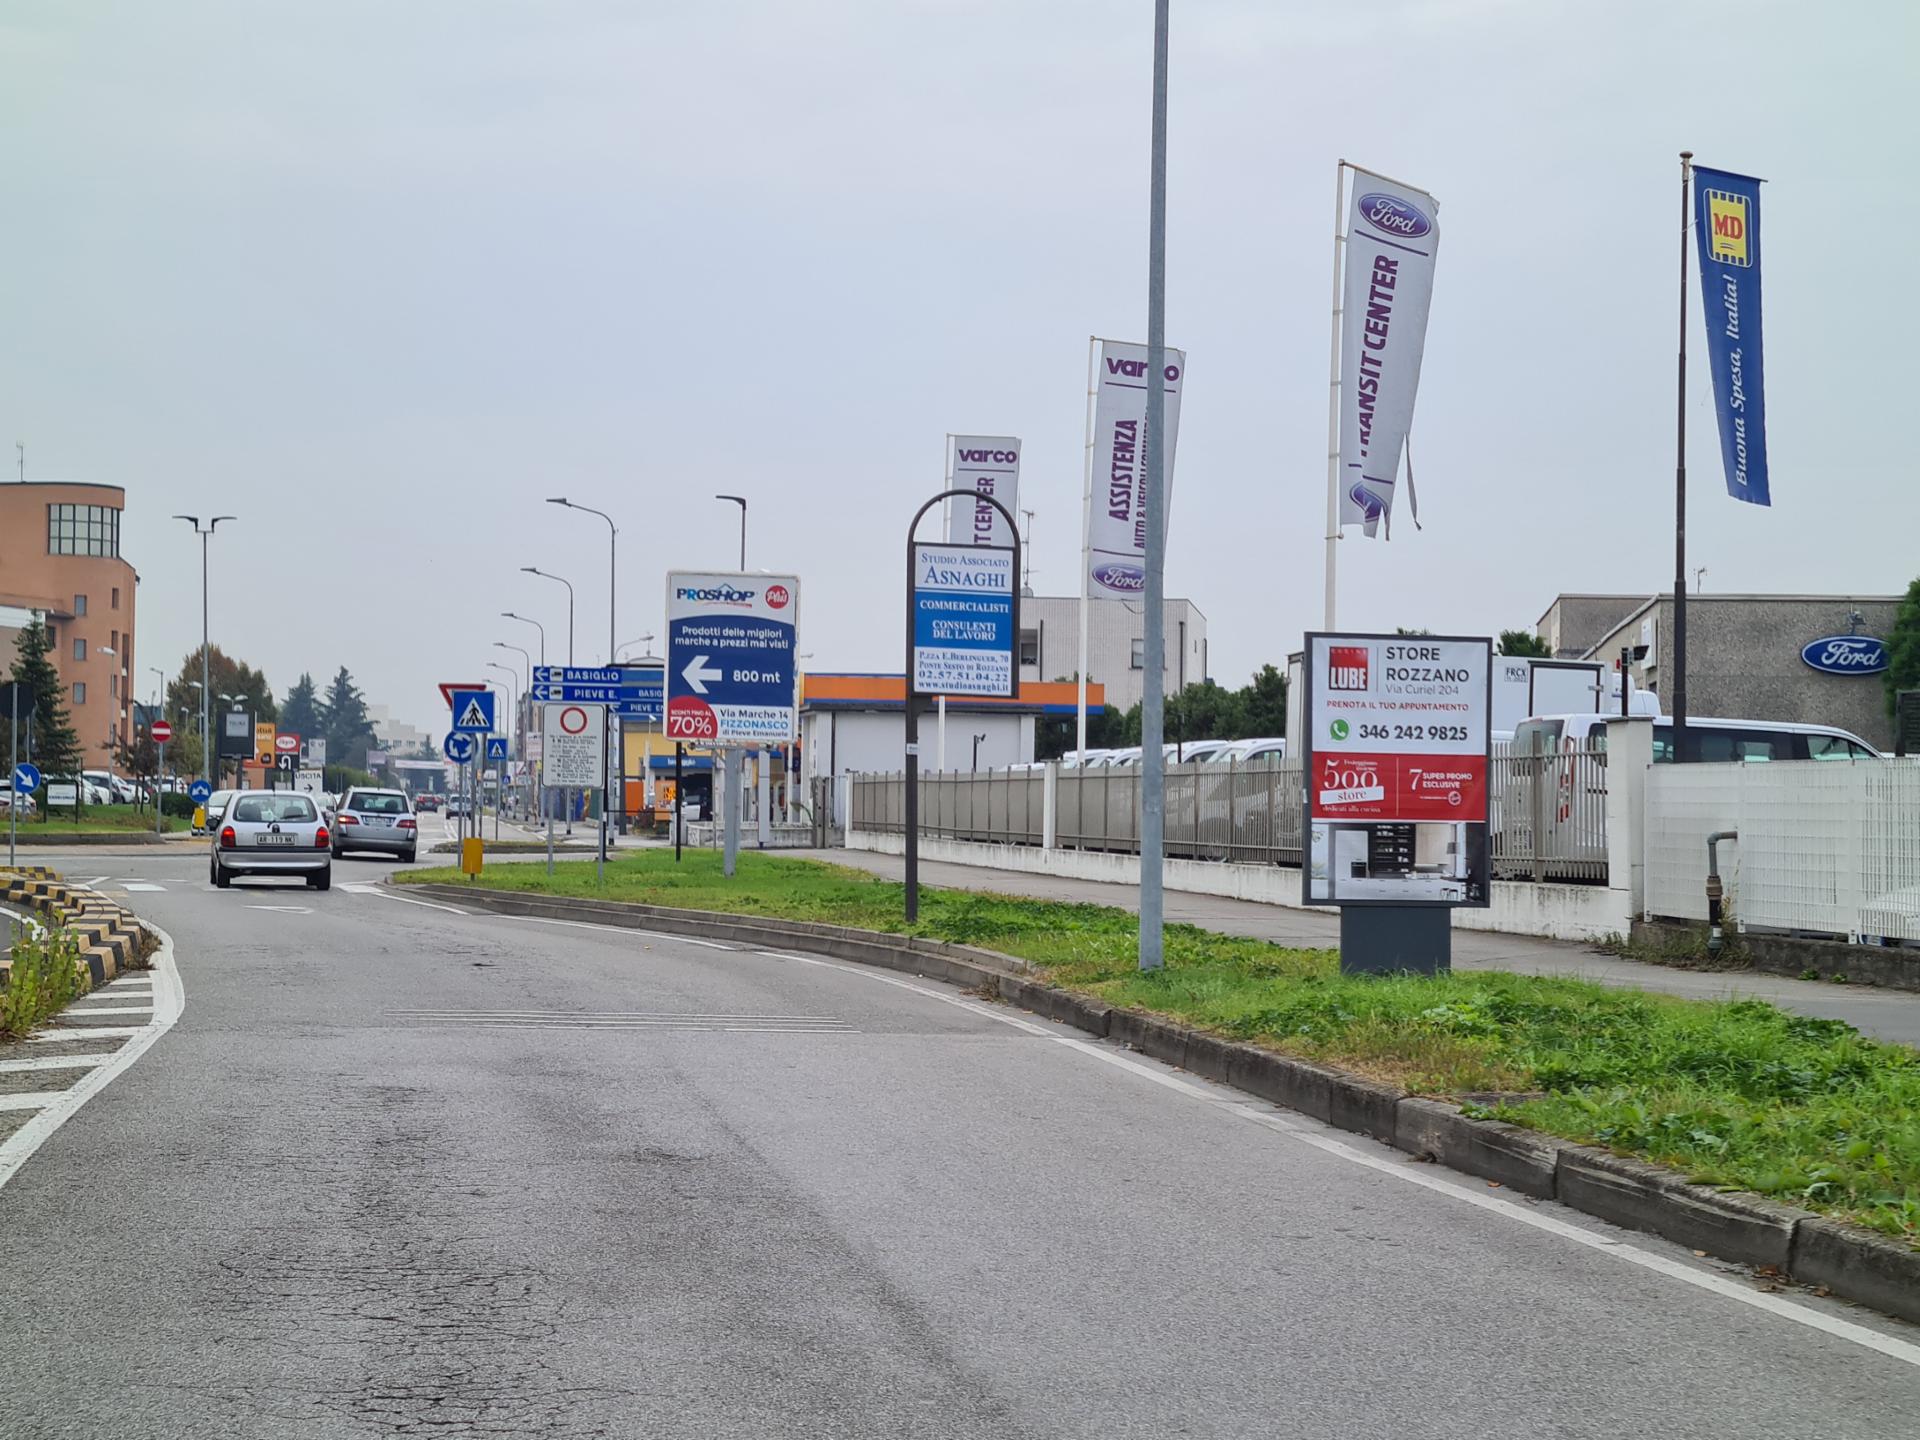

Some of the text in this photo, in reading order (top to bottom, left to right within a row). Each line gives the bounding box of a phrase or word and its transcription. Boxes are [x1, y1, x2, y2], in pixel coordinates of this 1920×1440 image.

[1370, 199, 1417, 233] Ford
[1713, 213, 1743, 239] MD
[1363, 255, 1398, 350] CENTER
[1106, 357, 1179, 381] varo
[1722, 274, 1747, 486] Buona Spesa, Italia!
[958, 449, 1017, 463] varco
[1108, 420, 1137, 522] ASSISTENZA
[921, 553, 1009, 567] STUDIO ASSOCIATO
[924, 565, 1006, 587] ASNAGHI
[677, 588, 755, 602] PROSHOP
[920, 600, 1008, 613] COMMERCIALISTI
[682, 626, 782, 640] Prodotti delle migliori
[932, 620, 996, 632] CONSULENTI
[933, 629, 995, 640] DEL LAVORO
[675, 637, 710, 646] marche
[720, 638, 748, 648] prezzi
[750, 639, 767, 648] mai
[769, 640, 788, 649] visti
[1386, 647, 1440, 661] STORE
[1821, 641, 1881, 665] Ford
[567, 668, 619, 680] BASIGLIO
[733, 670, 781, 683] 800 mt
[919, 671, 1008, 682] 02.57.51.04.22
[1330, 666, 1366, 689] LUBE
[1386, 668, 1469, 682] ROZZANO
[638, 689, 664, 697] BASIG
[919, 681, 1008, 692] www.studioasnaghi.it
[1386, 684, 1459, 695] Via Curiel 204
[574, 689, 618, 699] PIEVE E.
[1326, 700, 1366, 709] PRENOTA
[1400, 703, 1469, 711] APPUNTAMENTO
[720, 709, 788, 719] Via Marche 14
[670, 716, 712, 735] 70%
[720, 720, 788, 730] FIZZONASCO
[1359, 725, 1468, 741] 346 242 9825
[295, 772, 321, 780] USCITA
[1324, 759, 1378, 789] 500
[1409, 769, 1423, 790] 7
[1337, 791, 1367, 801] store
